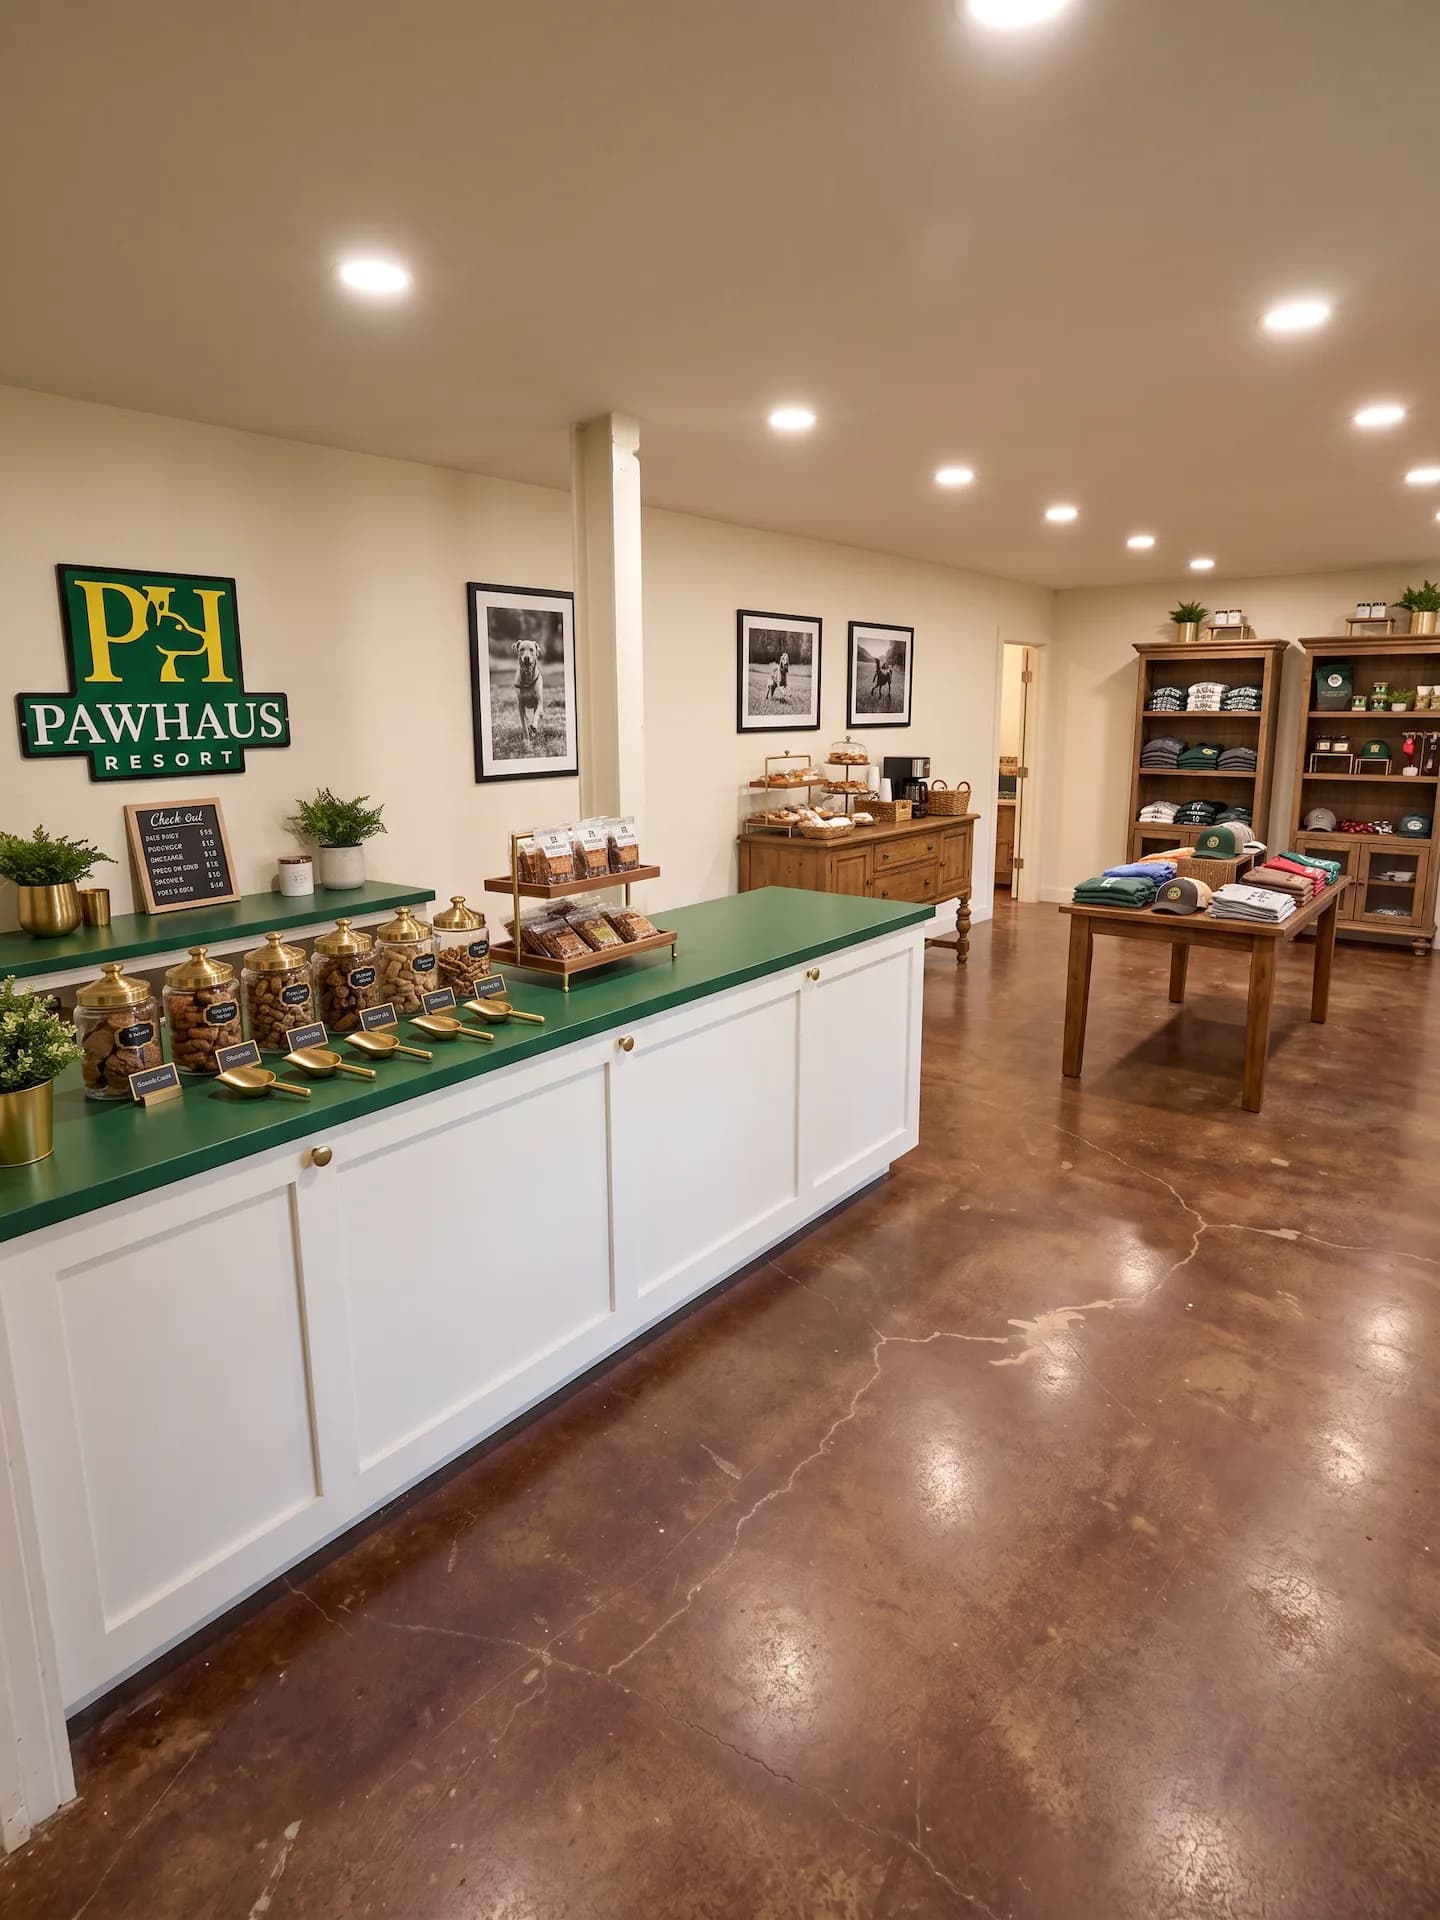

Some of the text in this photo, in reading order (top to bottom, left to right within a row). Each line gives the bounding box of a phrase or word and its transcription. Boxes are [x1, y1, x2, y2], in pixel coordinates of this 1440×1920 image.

[30, 702, 283, 746] PAWHAUS
[105, 750, 233, 771] RESORT
[150, 810, 203, 827] Check Out
